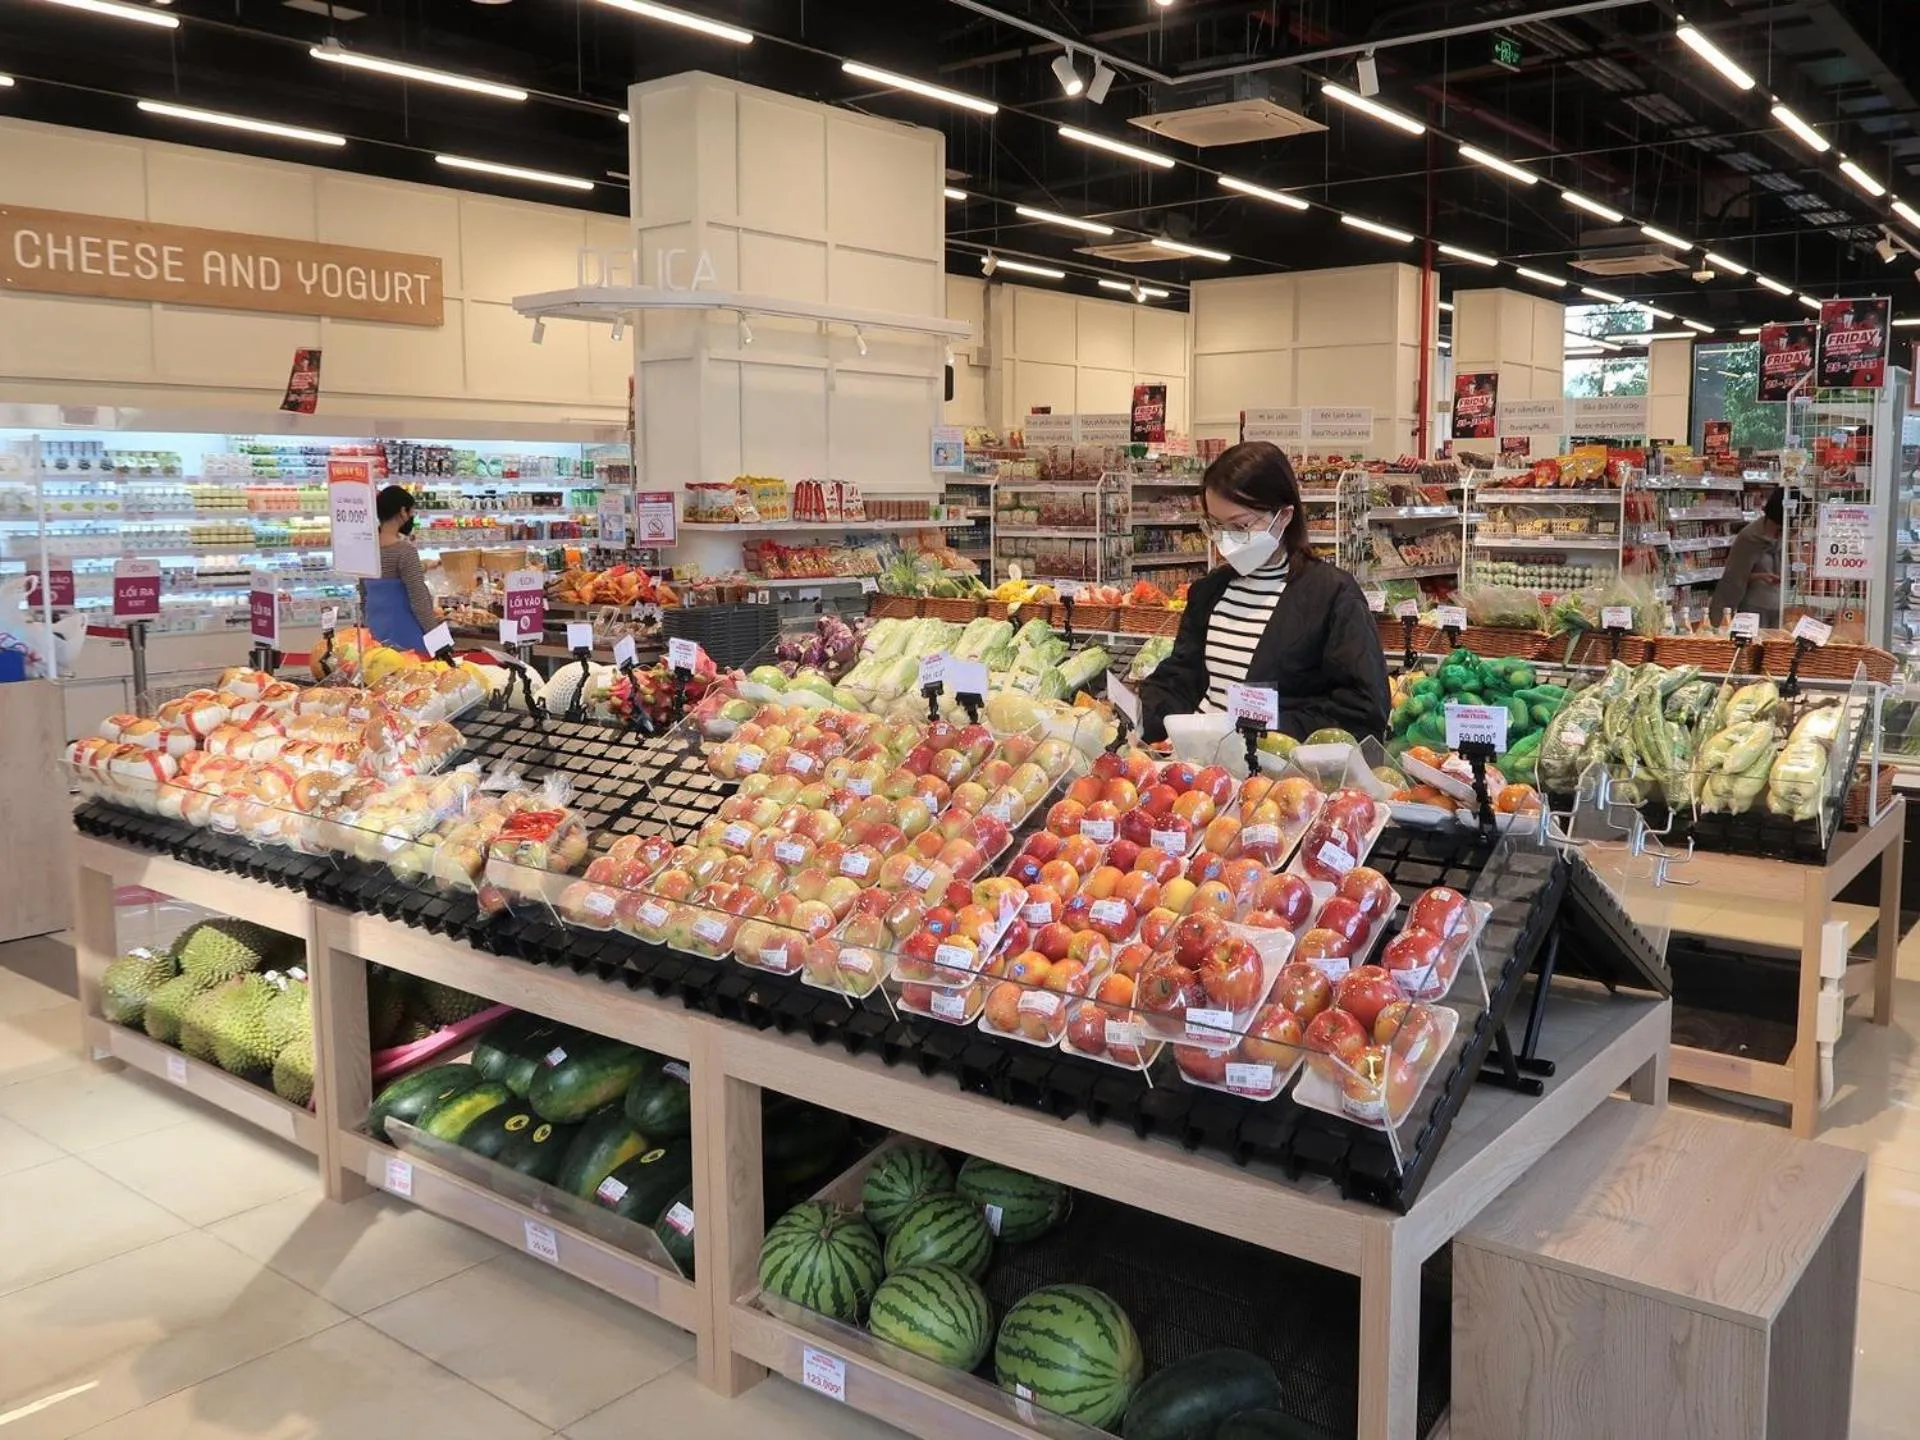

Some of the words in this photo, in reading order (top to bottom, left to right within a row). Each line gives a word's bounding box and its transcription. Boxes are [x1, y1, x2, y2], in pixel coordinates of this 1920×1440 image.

[13, 229, 185, 283] CHEESE
[203, 250, 281, 292] AND
[298, 260, 431, 306] YOGURT
[1827, 330, 1877, 346] FRIDAY
[1766, 351, 1809, 366] FRIDAY
[1458, 397, 1491, 408] FRIDAY
[139, 587, 155, 597] RA
[509, 595, 523, 608] LỐI
[524, 594, 541, 607] VÀO
